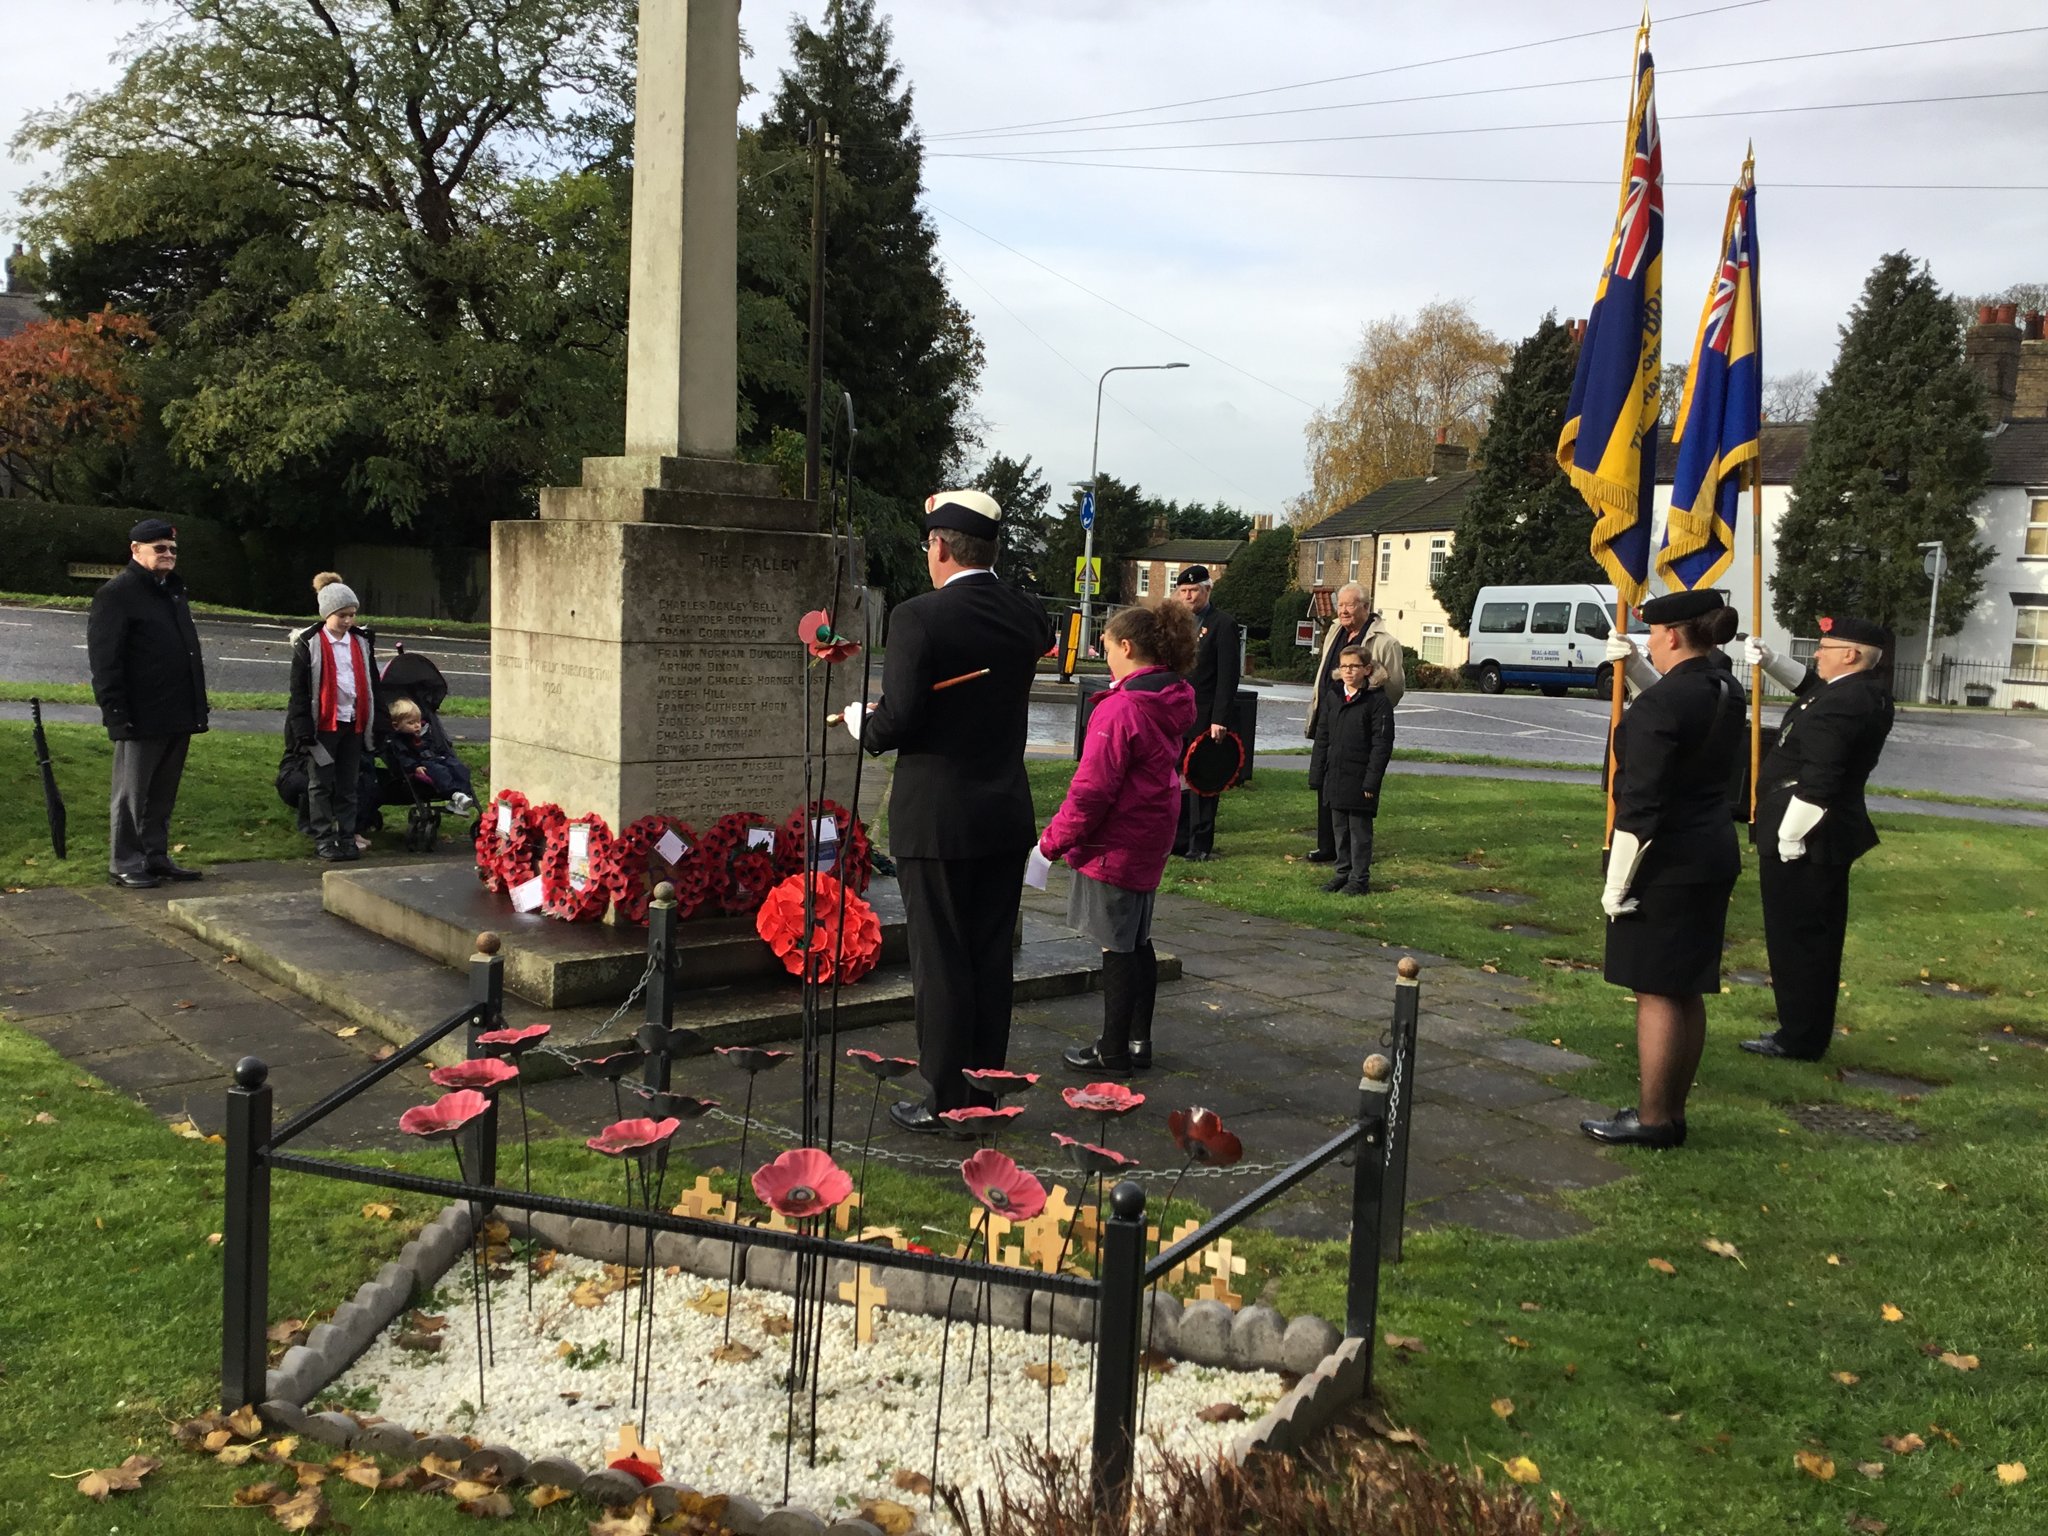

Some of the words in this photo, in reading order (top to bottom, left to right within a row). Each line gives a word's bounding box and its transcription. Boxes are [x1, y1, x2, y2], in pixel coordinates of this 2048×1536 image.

[699, 552, 728, 568] THE
[742, 555, 799, 571] FALLEN
[70, 565, 122, 576] BRIGSLEY
[658, 599, 706, 611] CHARLES
[660, 613, 722, 625] ALEXANDER
[657, 627, 694, 638] FRANK
[657, 648, 694, 659] FRANK
[699, 648, 745, 660] NORMAN
[659, 661, 702, 673] ARTHUR
[707, 662, 740, 673] DIXON
[657, 675, 702, 687] WILLIAM
[707, 675, 754, 686] CHARLES
[656, 689, 698, 700] JOSEPH
[703, 688, 727, 700] HILL
[656, 702, 700, 714] FRANCIS
[705, 702, 757, 713] CUTHBERT
[657, 716, 698, 727] SIDNEY
[701, 715, 749, 726] JOHNSON
[656, 730, 705, 741] CHARLES
